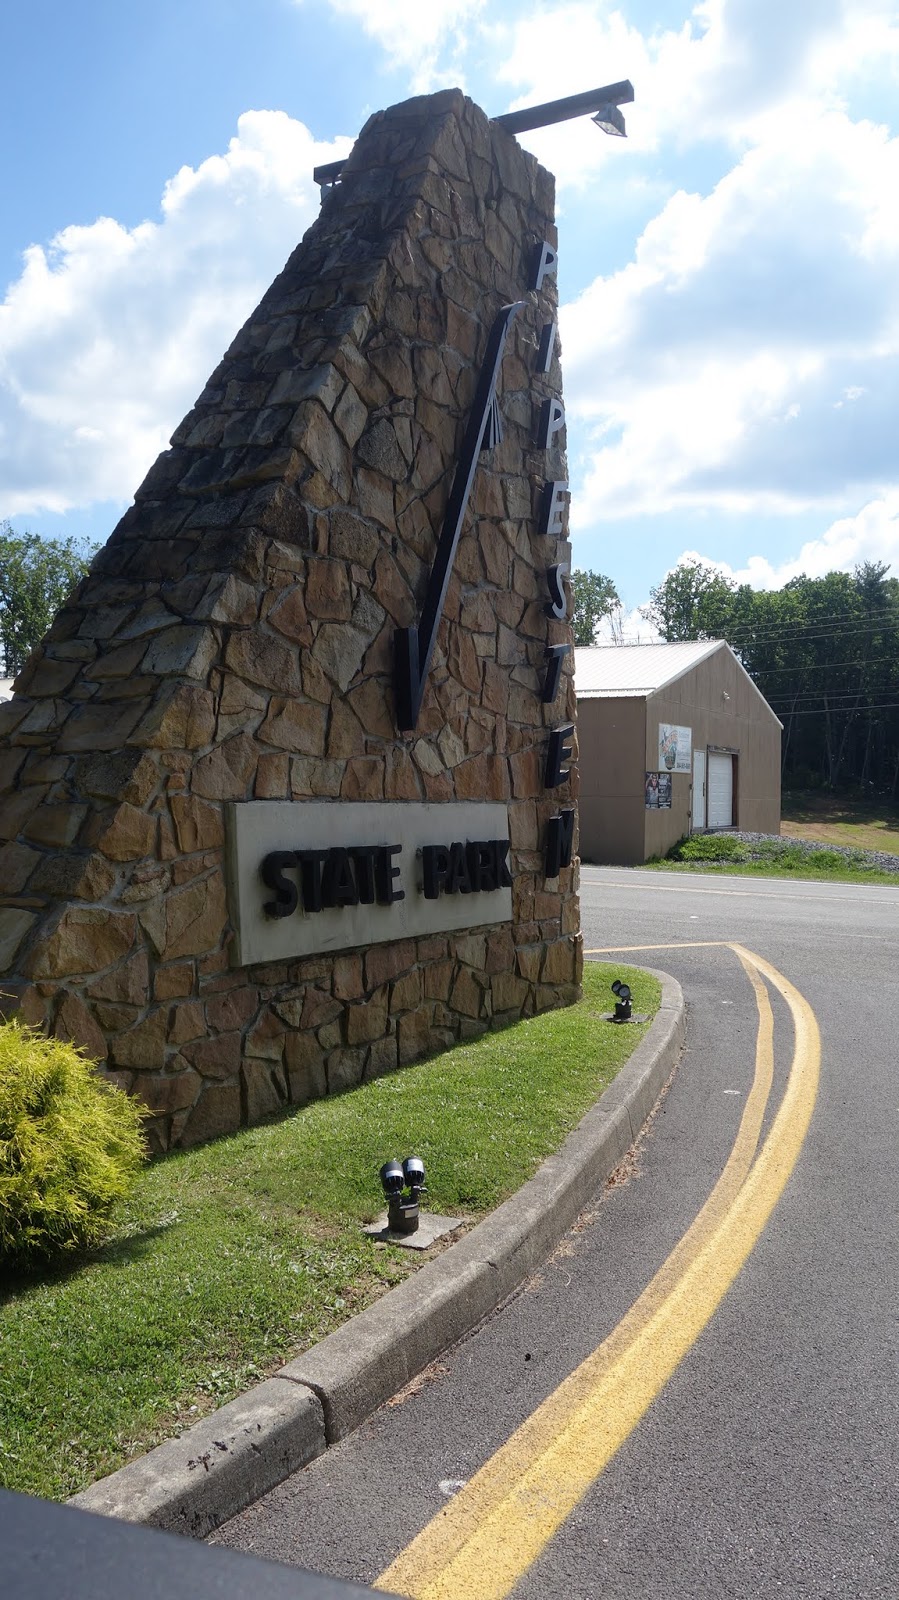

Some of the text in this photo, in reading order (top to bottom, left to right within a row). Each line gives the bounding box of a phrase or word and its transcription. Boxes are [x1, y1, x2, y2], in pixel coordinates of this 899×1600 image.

[528, 241, 575, 878] PIPESTEM
[262, 839, 512, 917] STATE PARK
